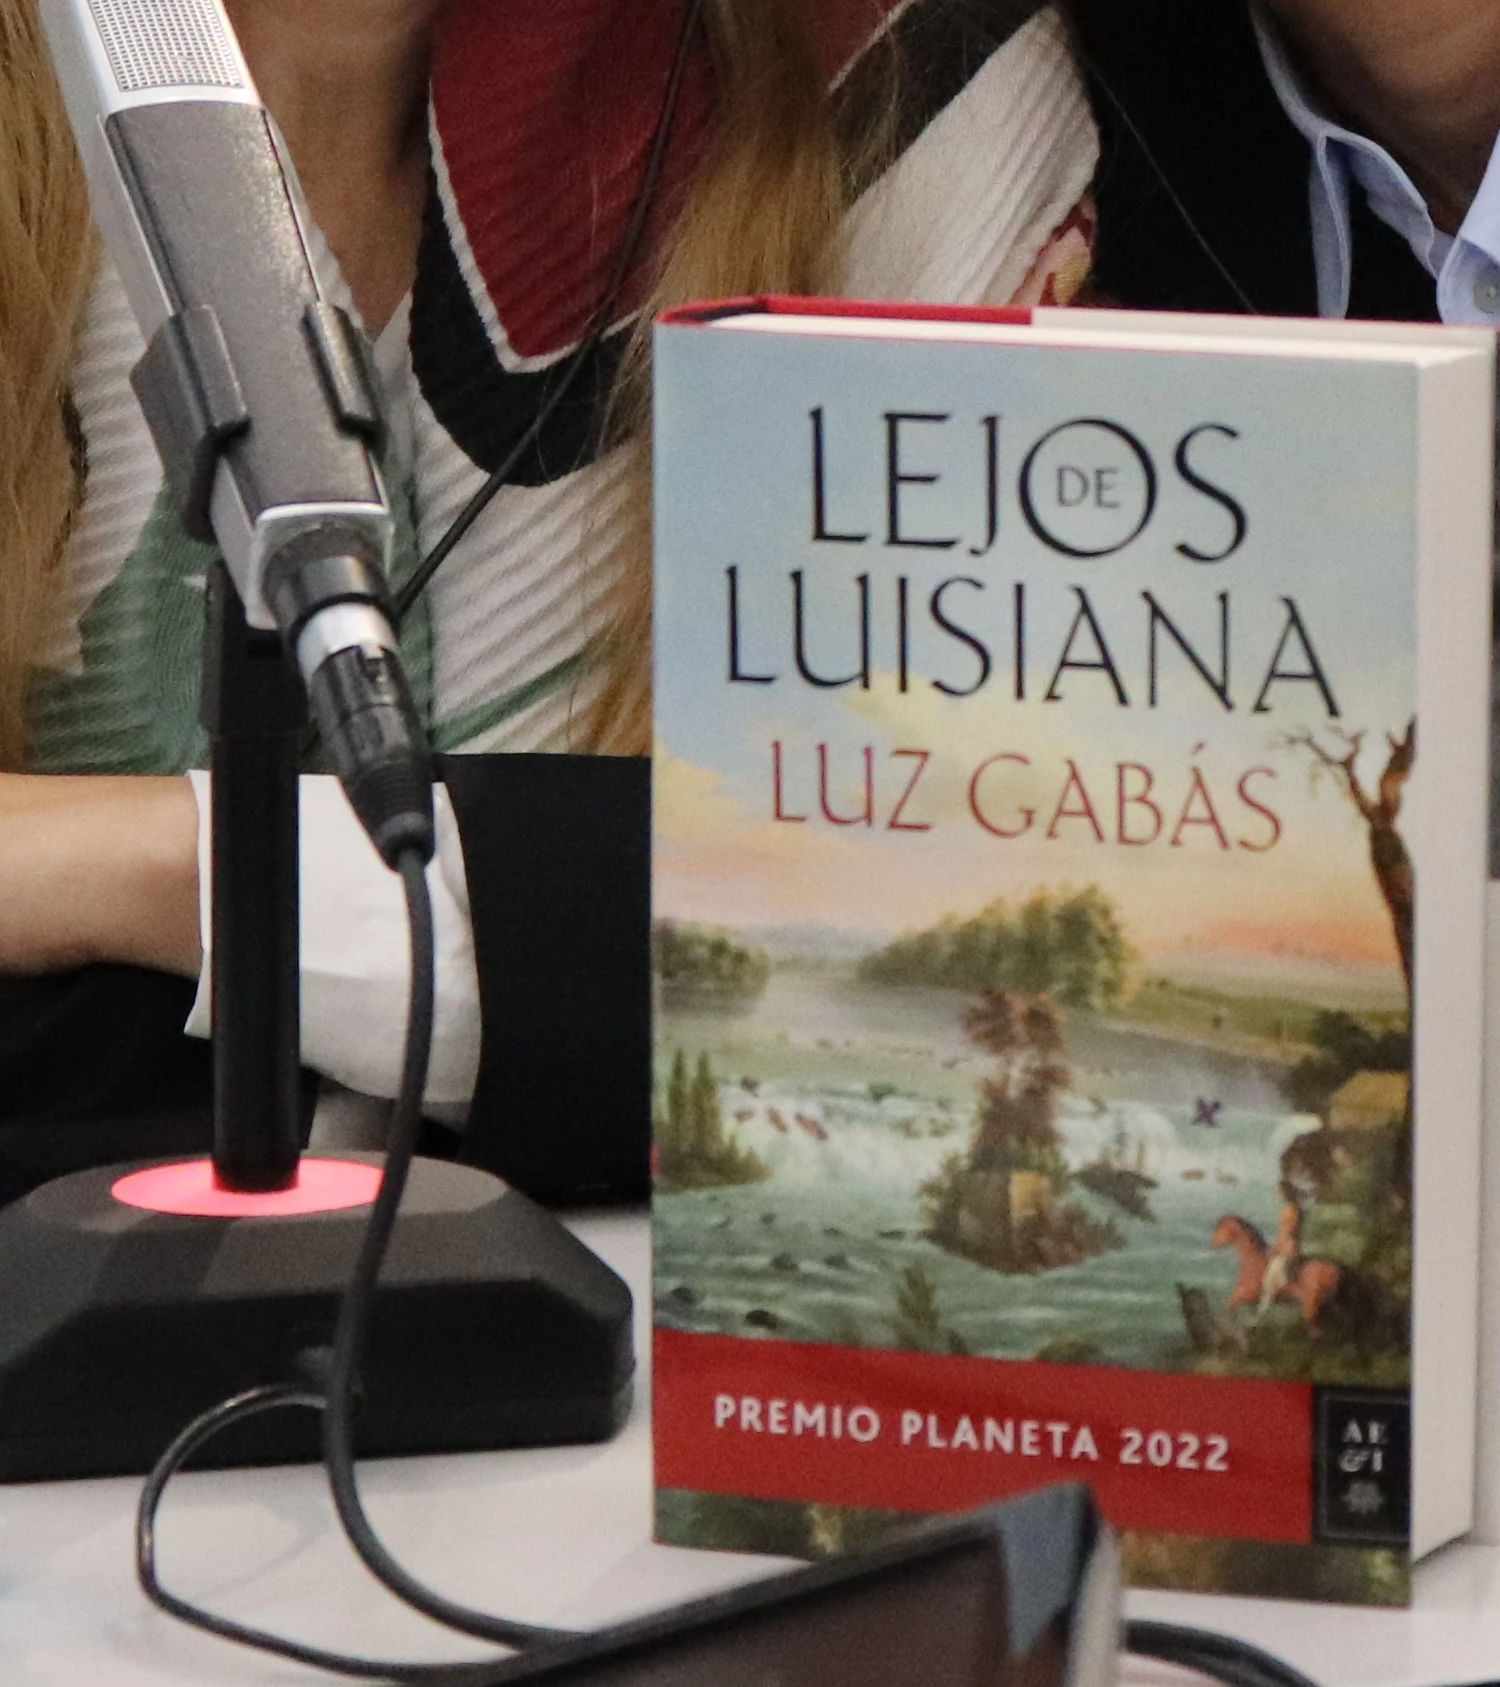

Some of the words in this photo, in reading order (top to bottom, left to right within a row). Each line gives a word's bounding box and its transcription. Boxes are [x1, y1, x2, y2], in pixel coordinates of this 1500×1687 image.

[808, 405, 1250, 564] LEJOS
[1055, 464, 1121, 508] DE
[724, 565, 1342, 718] LUISIANA
[770, 739, 934, 832] LUZ
[967, 741, 1283, 853] GABÁS
[713, 1393, 882, 1443] PREMIO
[900, 1410, 1100, 1461] PLANETA
[1119, 1427, 1230, 1473] 2022
